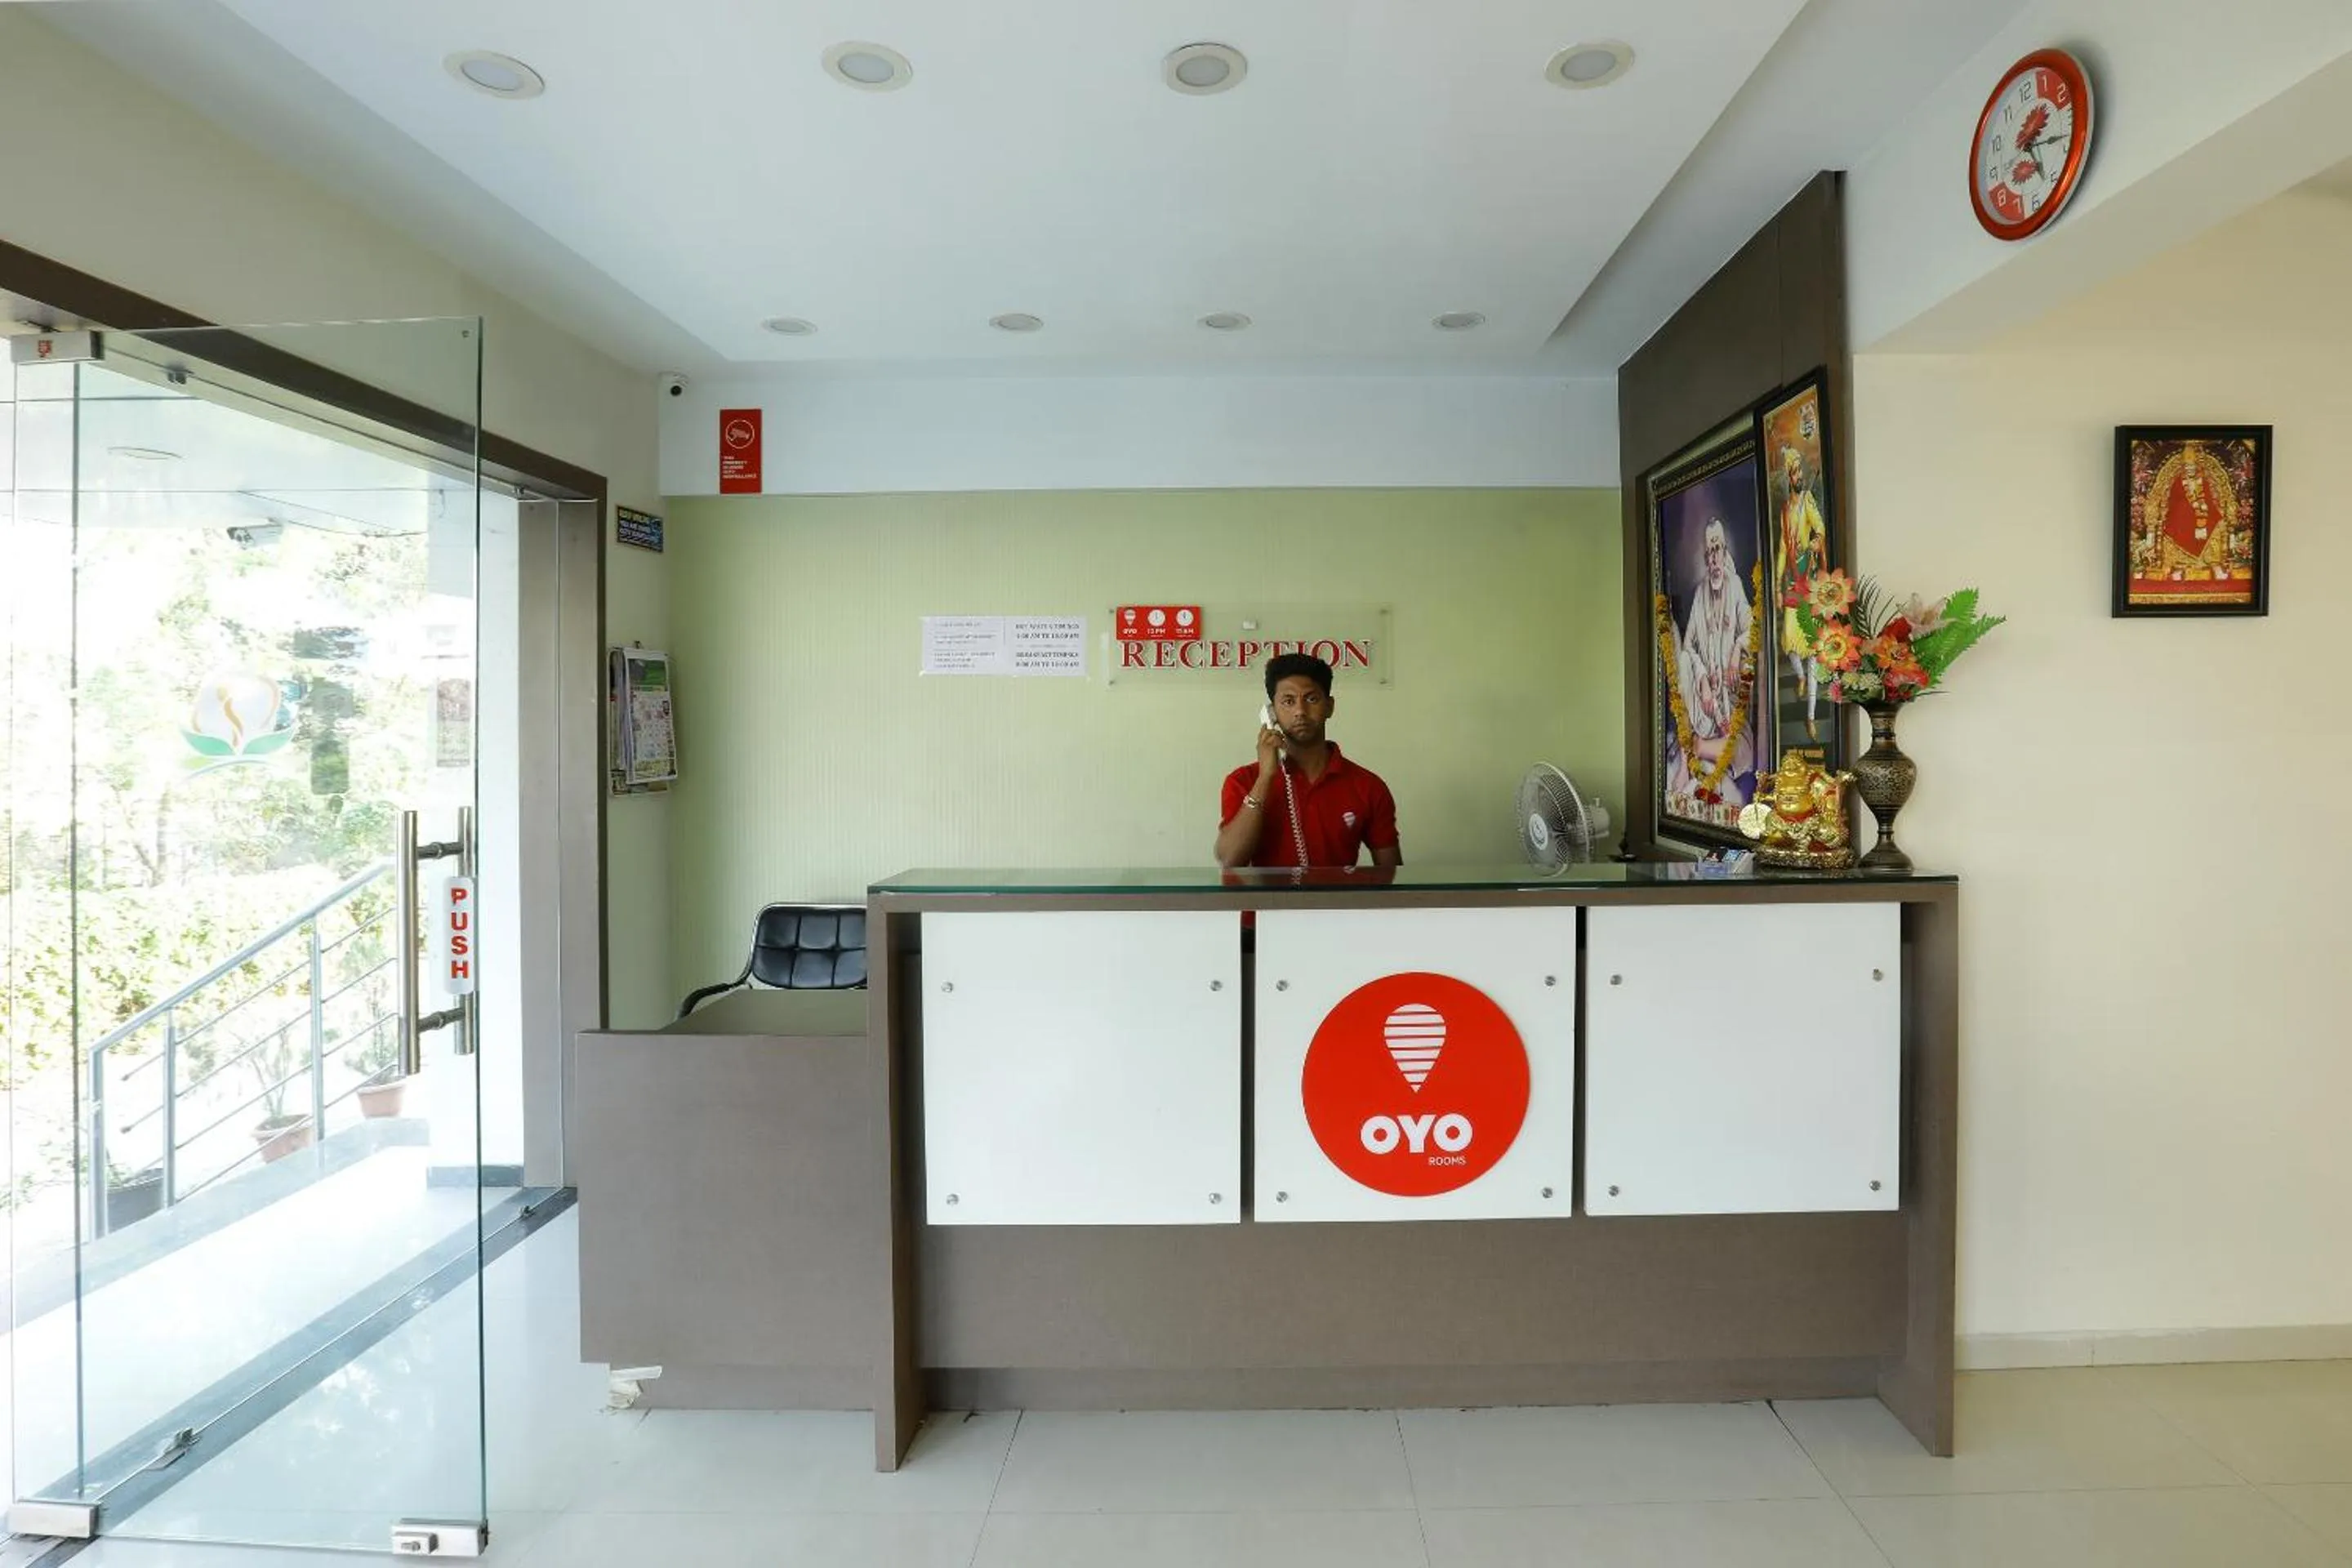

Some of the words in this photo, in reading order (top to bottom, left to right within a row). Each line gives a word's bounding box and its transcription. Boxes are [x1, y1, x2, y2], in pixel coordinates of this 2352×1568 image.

[2041, 74, 2047, 92] 1
[2018, 81, 2032, 104] 12
[2056, 82, 2067, 103] 2
[2003, 105, 2013, 123] 11
[1992, 135, 2002, 154] 10
[1989, 166, 1998, 181] 9
[1997, 189, 2007, 207] 8
[2012, 197, 2022, 213] 7
[2031, 194, 2041, 212] 6
[1120, 640, 1374, 669] RECEPTION
[451, 888, 469, 979] PUSH
[1360, 1113, 1473, 1155] OYO
[1428, 1156, 1467, 1166] ROOMS
